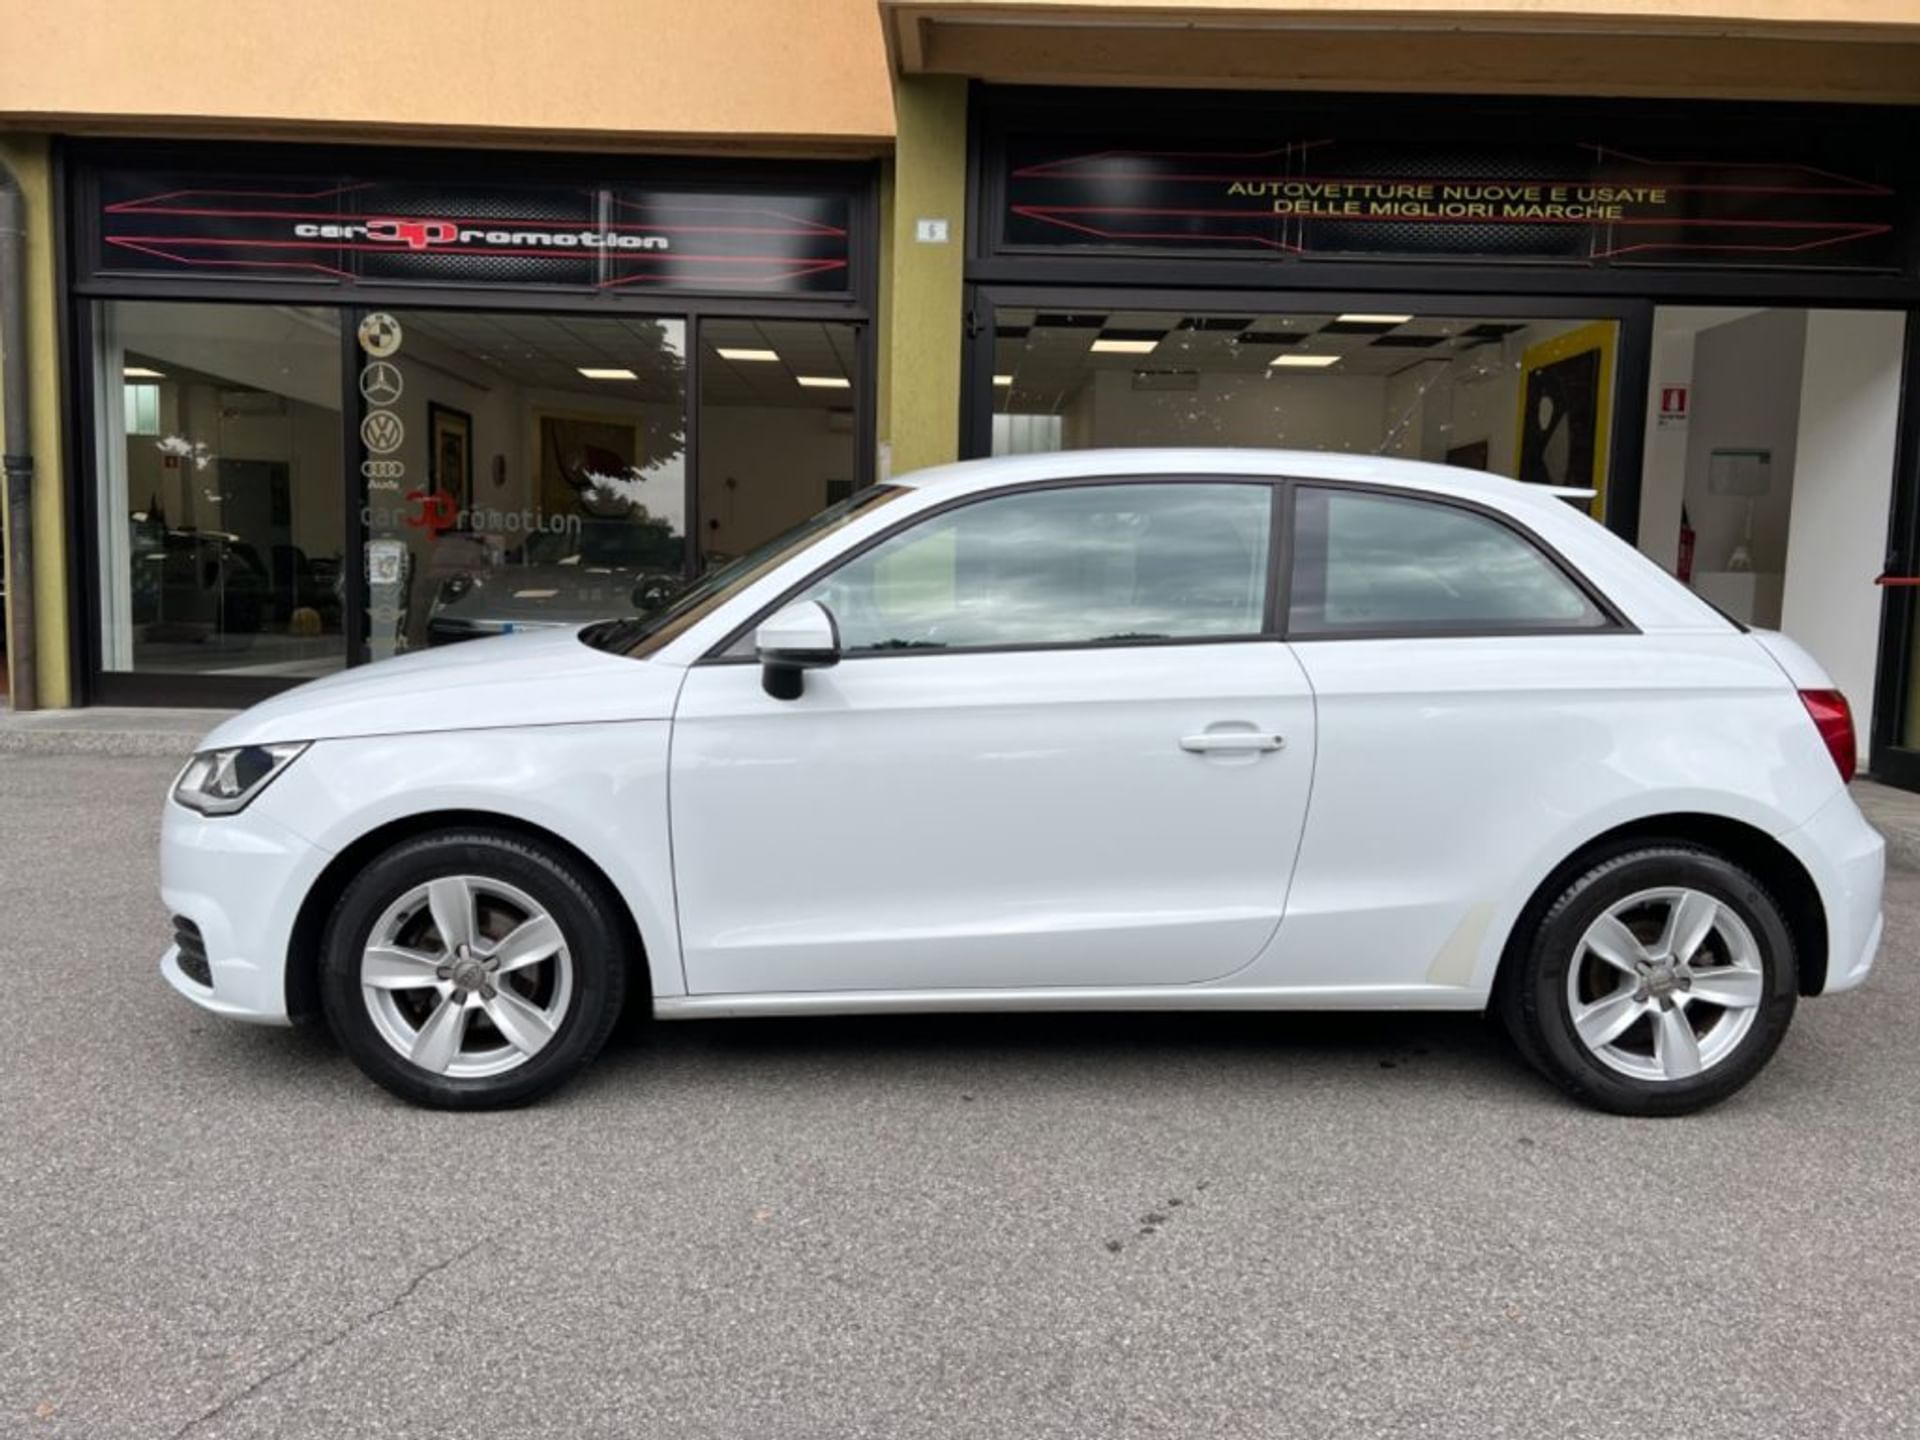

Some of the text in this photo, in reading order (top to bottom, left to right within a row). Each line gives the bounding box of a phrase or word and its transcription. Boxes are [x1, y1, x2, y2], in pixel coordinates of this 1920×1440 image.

[1227, 181, 1667, 204] AUTOVETTURE NUOVE E USATE
[1273, 199, 1624, 219] DELLE MIGLIORI MARCHE
